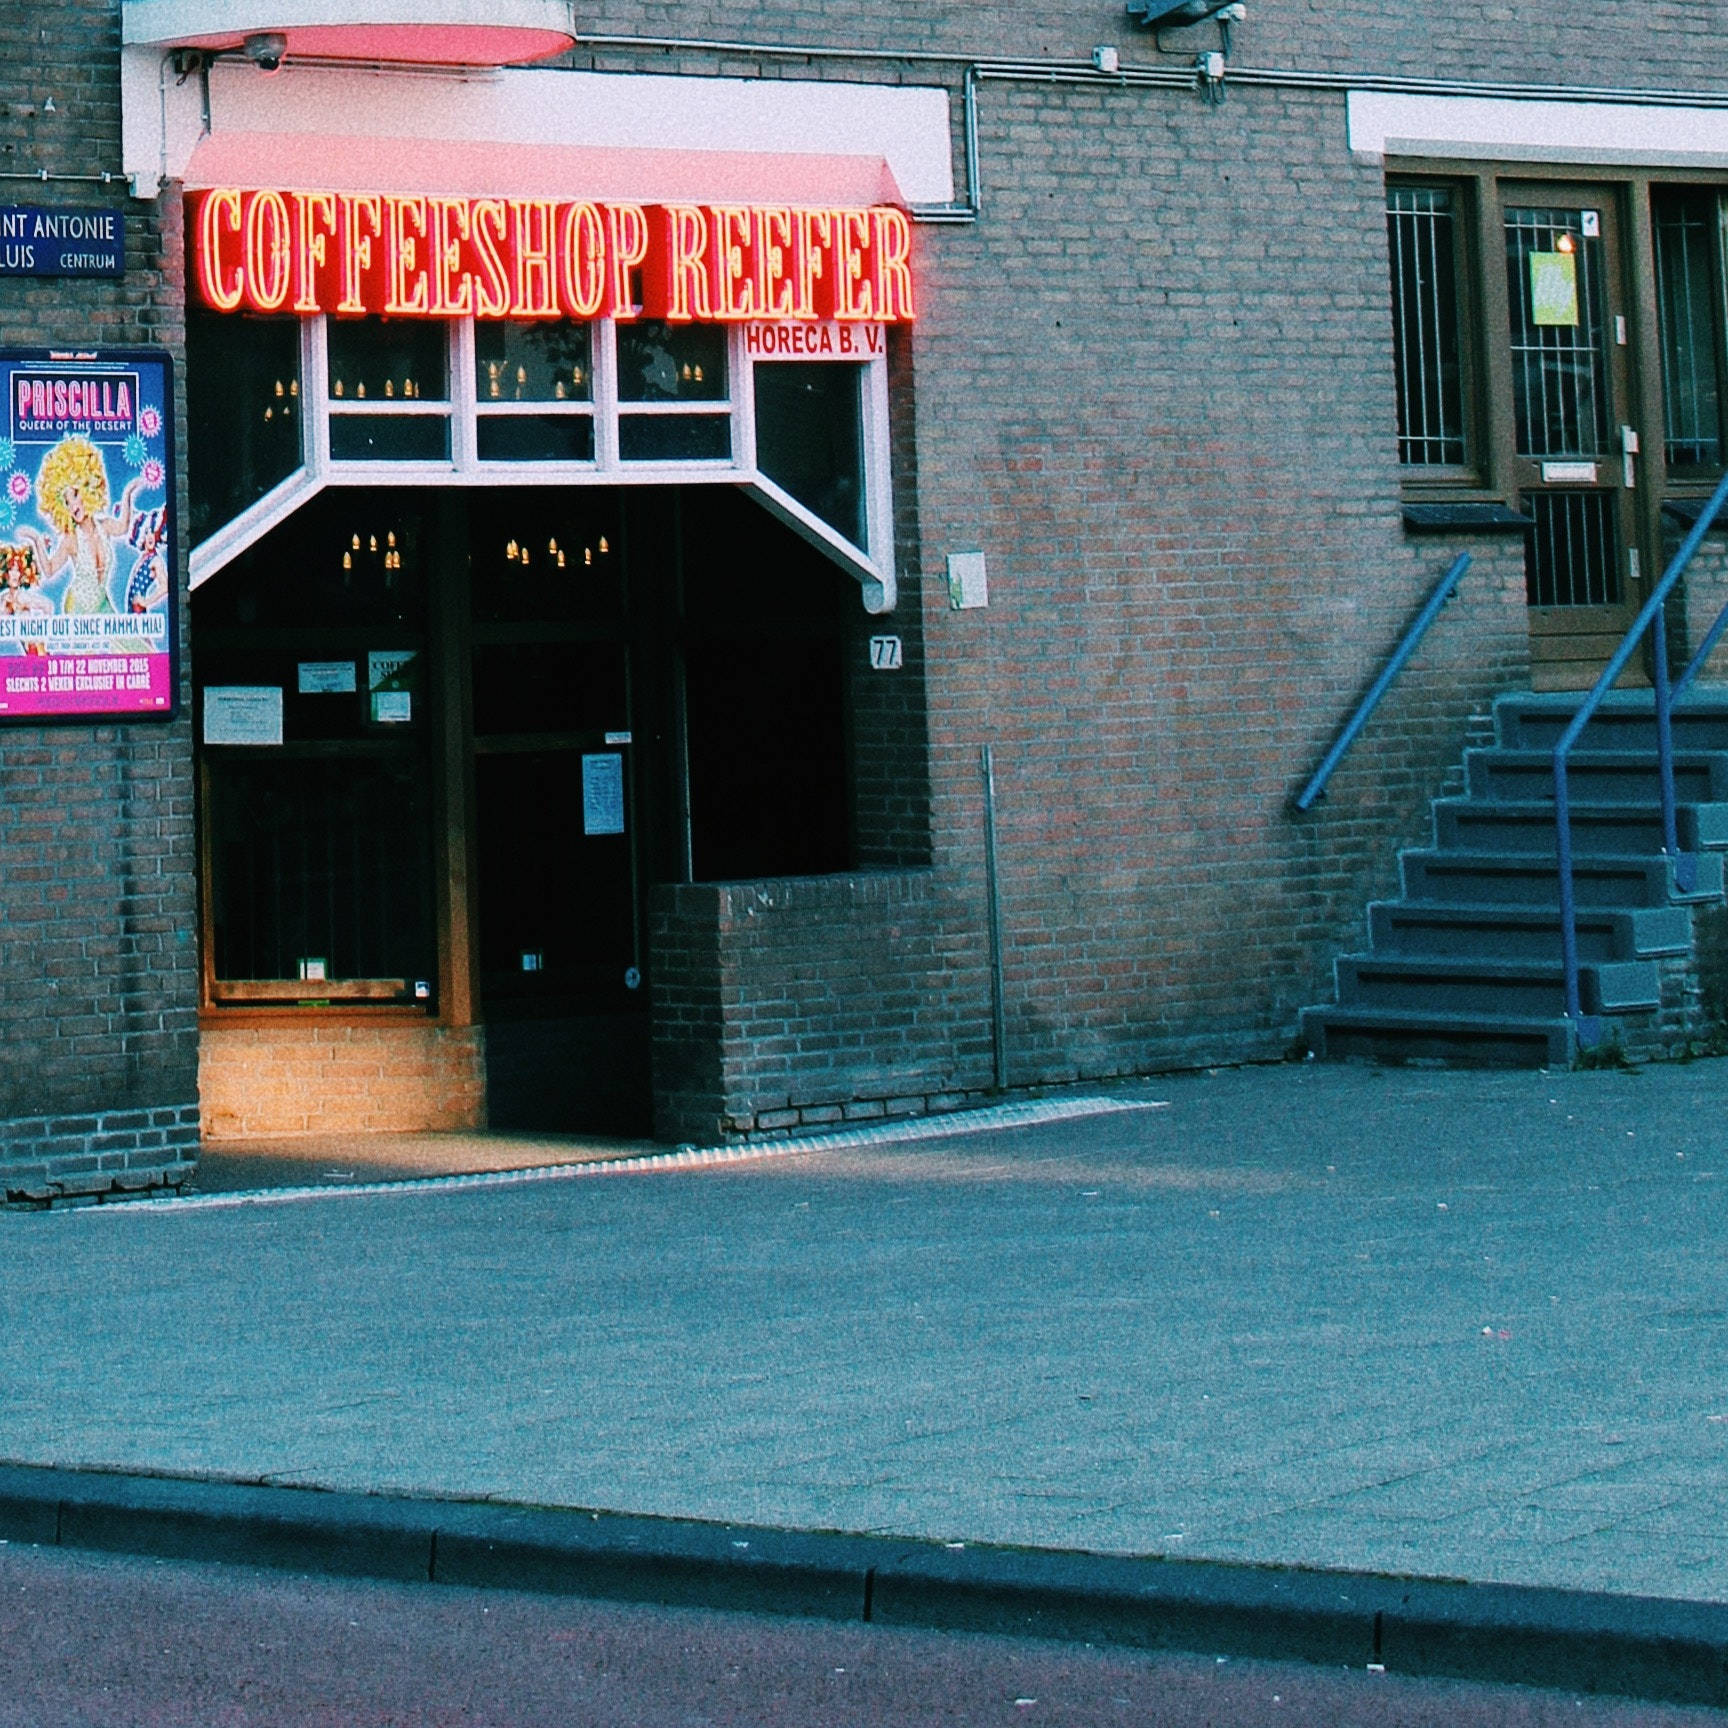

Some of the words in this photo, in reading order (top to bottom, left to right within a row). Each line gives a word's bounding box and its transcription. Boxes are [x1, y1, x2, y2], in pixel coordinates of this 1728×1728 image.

[33, 214, 115, 240] ANTONIE
[60, 252, 115, 269] CENTRUM
[201, 188, 648, 318] COFFEESHOP
[661, 203, 917, 321] REEFER
[747, 325, 833, 354] HORECA
[18, 380, 132, 420] PRISCILLA
[19, 421, 53, 431] QUEEN
[56, 421, 70, 431] OF
[72, 421, 91, 431] THE
[94, 421, 132, 431] DESERT
[21, 619, 48, 637] NIGHT
[52, 618, 70, 636] OUT
[73, 618, 101, 636] SINCE
[104, 617, 139, 636] MAMMA
[142, 616, 162, 635] MIA!
[873, 639, 897, 665] 77
[75, 659, 86, 675] 22
[87, 658, 128, 674] NOVEMBER
[129, 657, 149, 673] 2015
[40, 676, 47, 691] 2
